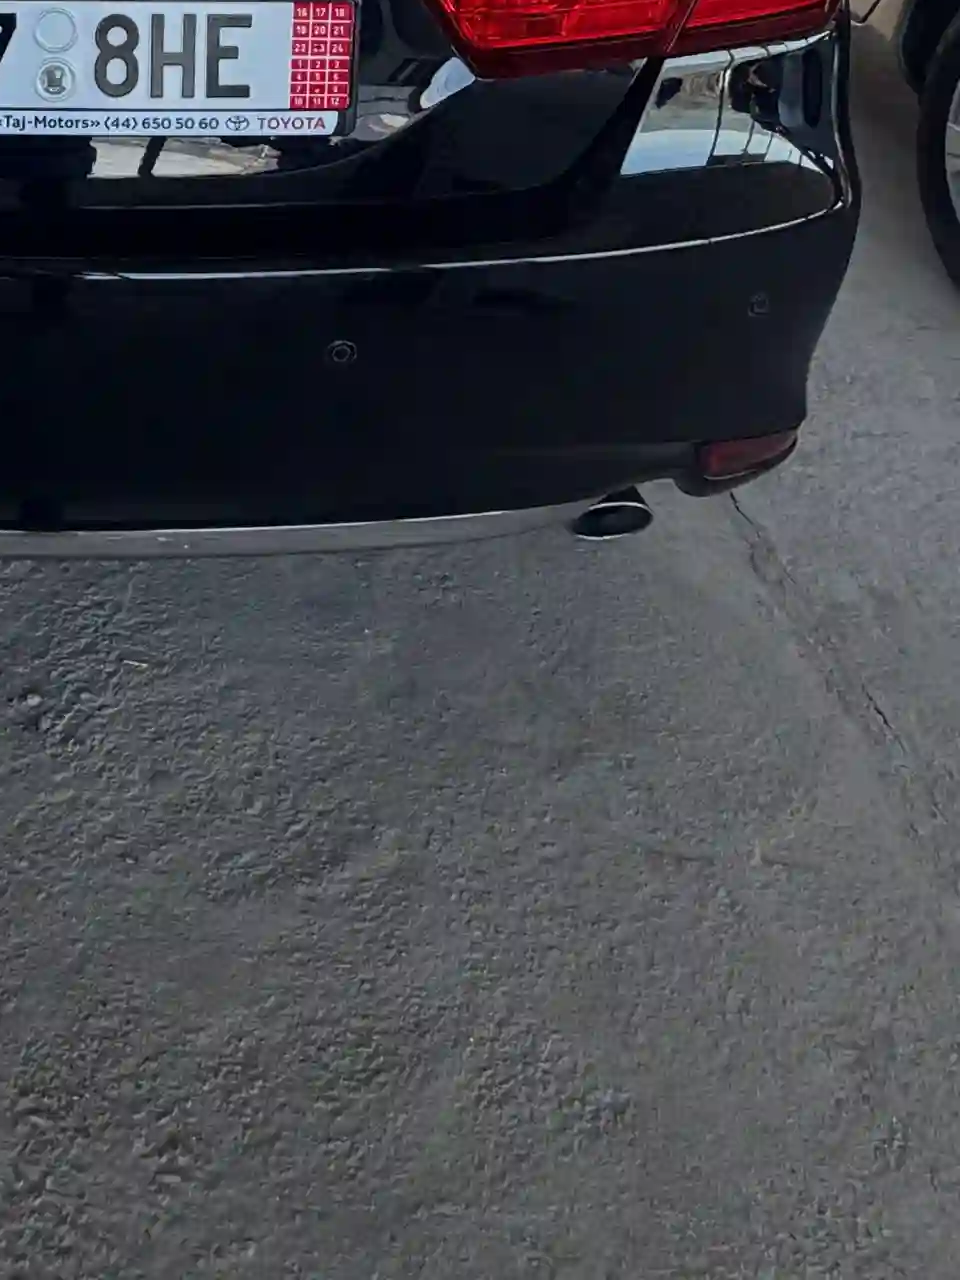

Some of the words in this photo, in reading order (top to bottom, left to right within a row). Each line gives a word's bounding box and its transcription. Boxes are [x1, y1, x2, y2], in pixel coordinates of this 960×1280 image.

[314, 26, 326, 35] 20
[333, 26, 344, 35] 21
[93, 13, 253, 100] 8HE
[103, 116, 138, 131] (44)
[141, 118, 171, 130] 650
[174, 118, 195, 130] 50
[198, 118, 220, 130] 60
[256, 117, 326, 130] TOYOTA
